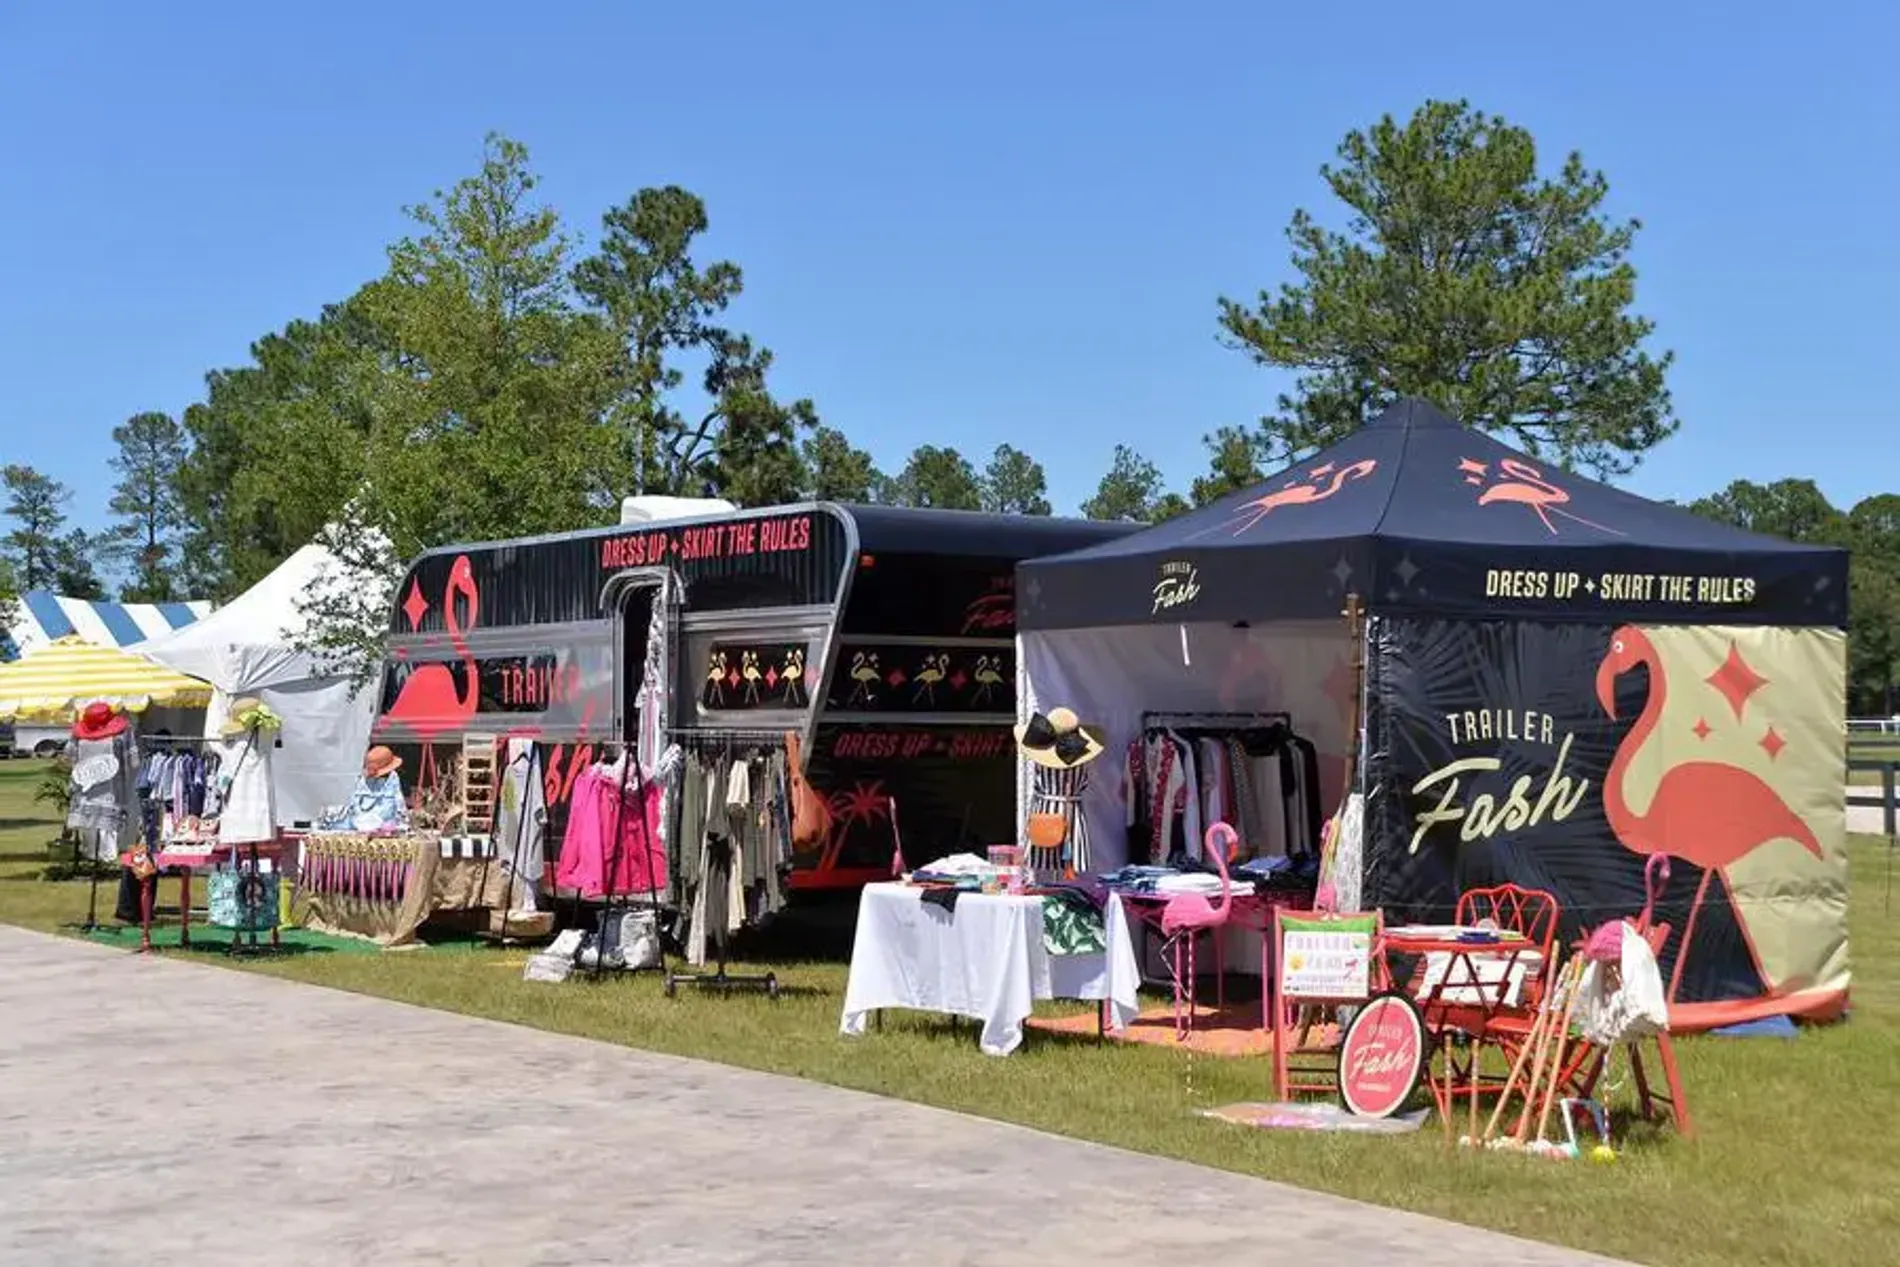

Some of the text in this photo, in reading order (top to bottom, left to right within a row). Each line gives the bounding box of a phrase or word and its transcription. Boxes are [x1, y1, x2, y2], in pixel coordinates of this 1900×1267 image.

[602, 517, 810, 568] DRESS UP SKIRT THE RULES
[1152, 568, 1200, 614] Fash
[1486, 570, 1756, 603] DRESS UP SKIRT THE RULES
[833, 731, 899, 758] DRESS
[901, 731, 934, 758] UP
[1446, 708, 1554, 745] TRAILER
[1408, 732, 1589, 856] Fash
[1348, 1035, 1415, 1081] Fash
